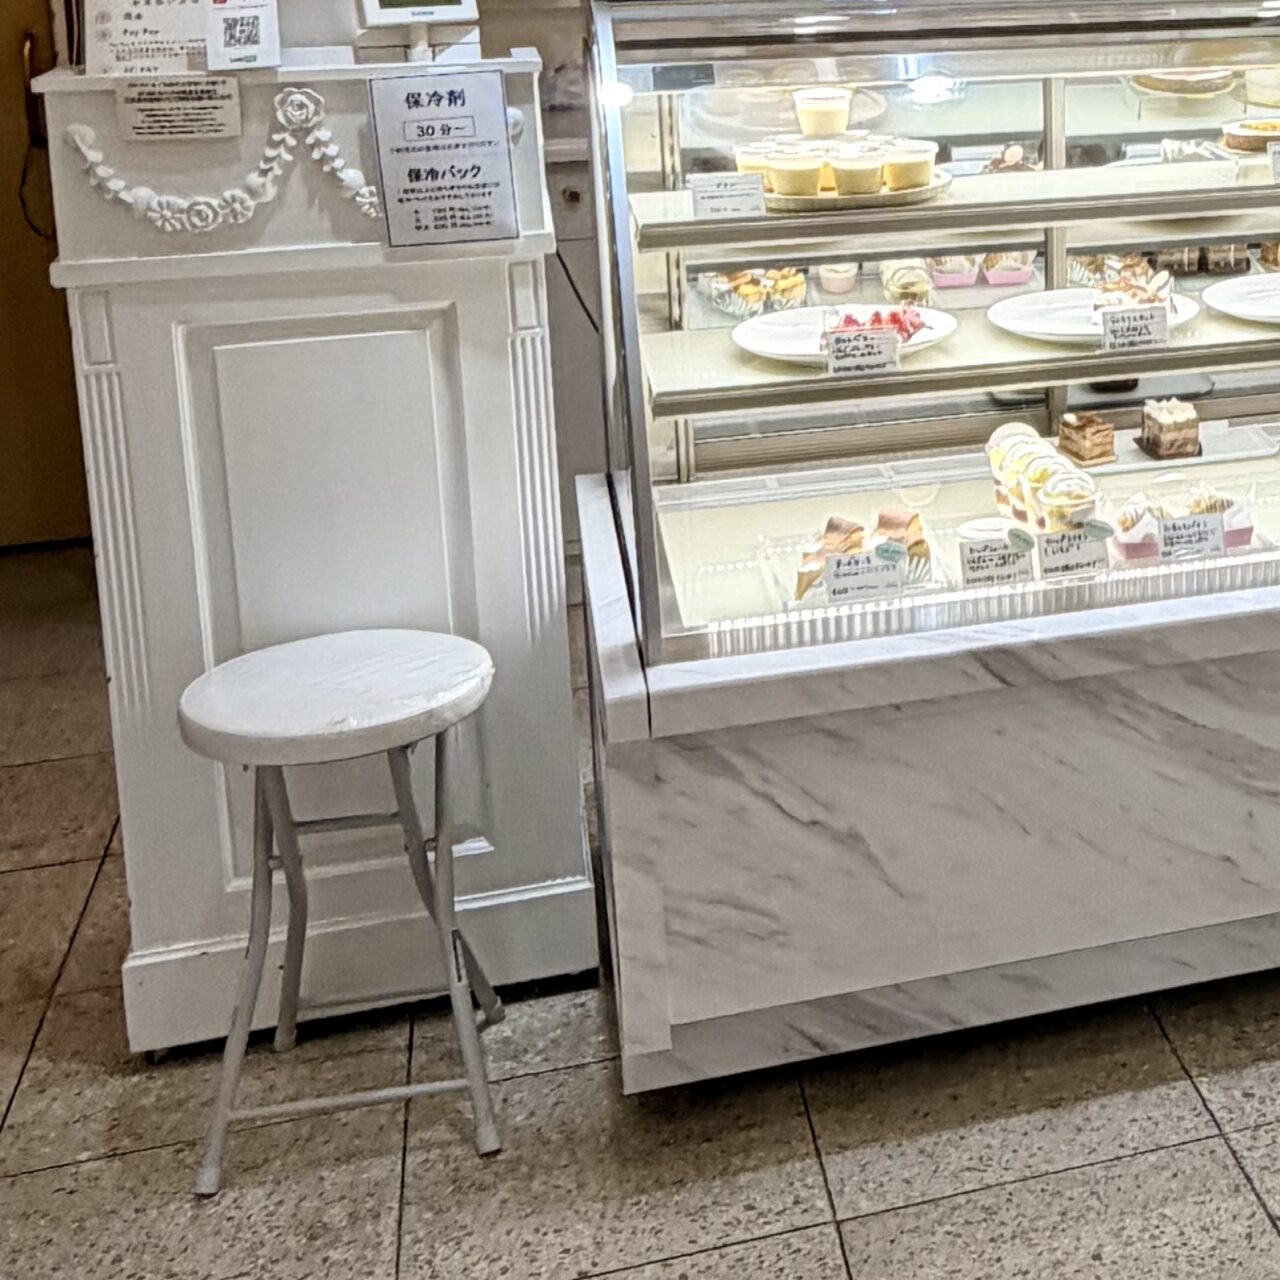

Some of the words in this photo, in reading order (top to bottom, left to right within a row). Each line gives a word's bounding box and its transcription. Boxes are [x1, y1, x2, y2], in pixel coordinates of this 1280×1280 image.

[405, 88, 466, 110] 保冷剤
[407, 164, 481, 183] 保冷パック
